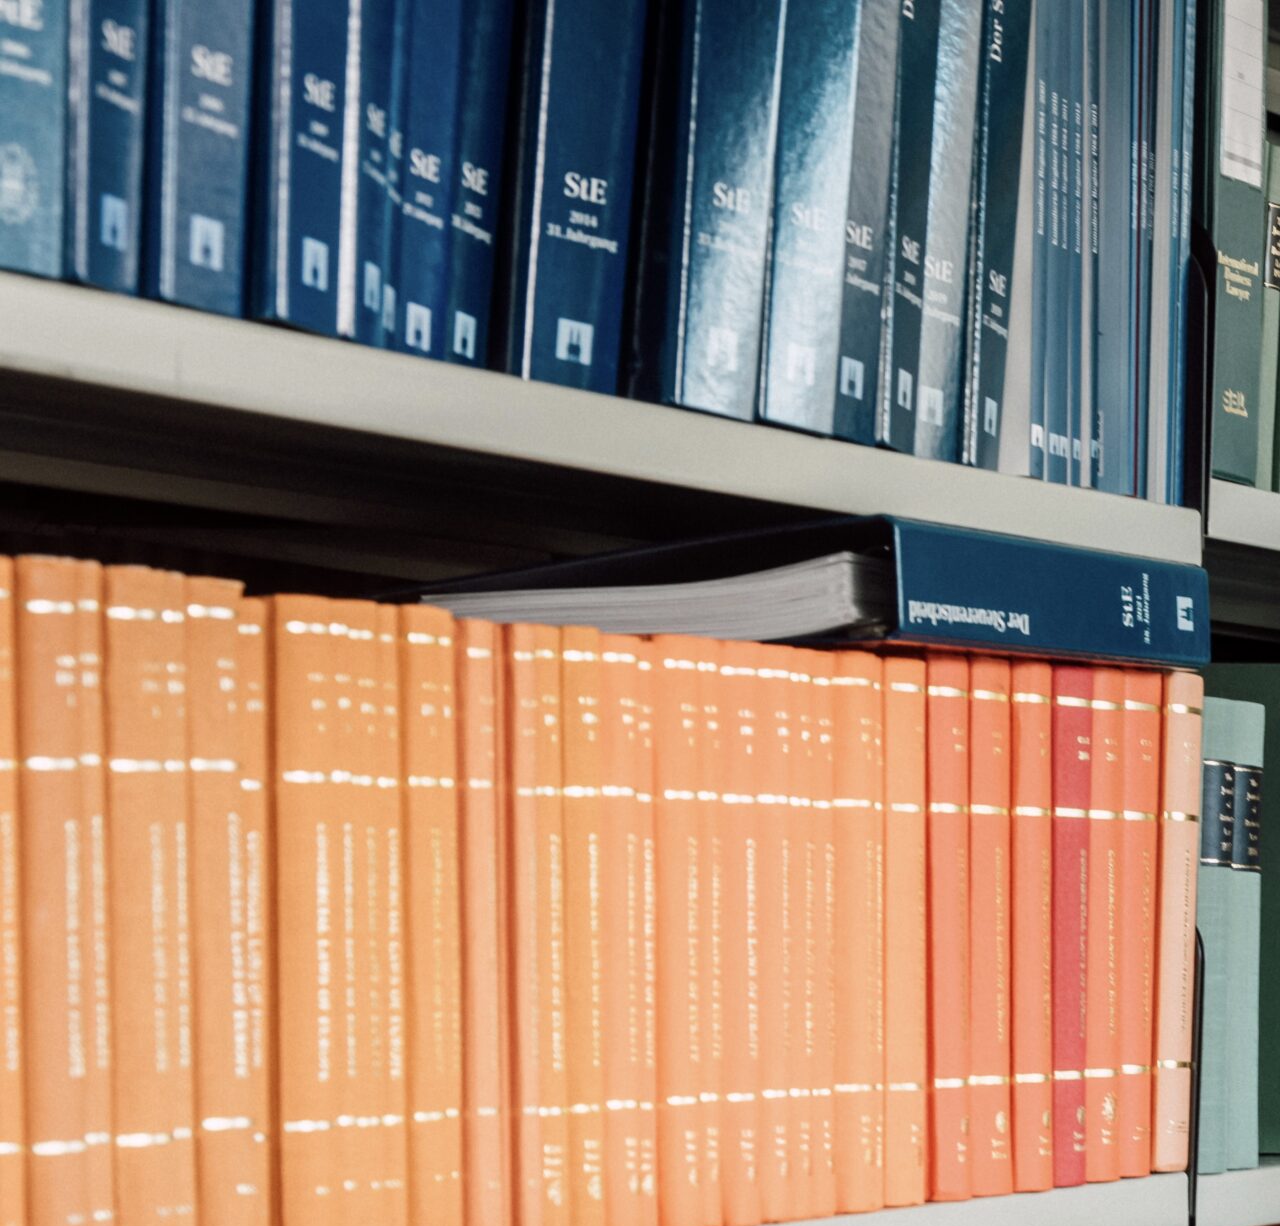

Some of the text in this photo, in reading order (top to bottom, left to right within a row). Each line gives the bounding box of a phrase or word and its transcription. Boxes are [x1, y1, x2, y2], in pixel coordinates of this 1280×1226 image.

[990, 19, 1004, 63] Der
[191, 44, 233, 87] StE
[303, 73, 336, 112] StE
[410, 147, 441, 184] StE
[461, 161, 490, 197] StE
[563, 171, 608, 205] StE
[712, 181, 751, 214] StE
[791, 202, 827, 231] StE
[846, 220, 873, 251] StE
[901, 234, 921, 265] StE
[925, 256, 954, 283] StE
[1217, 249, 1259, 277] International
[1224, 266, 1252, 287] Business
[988, 269, 1008, 298] StE
[1225, 281, 1252, 302] Lawyer
[908, 600, 1030, 636] Der Steuerentscheid
[1120, 585, 1134, 628] StE
